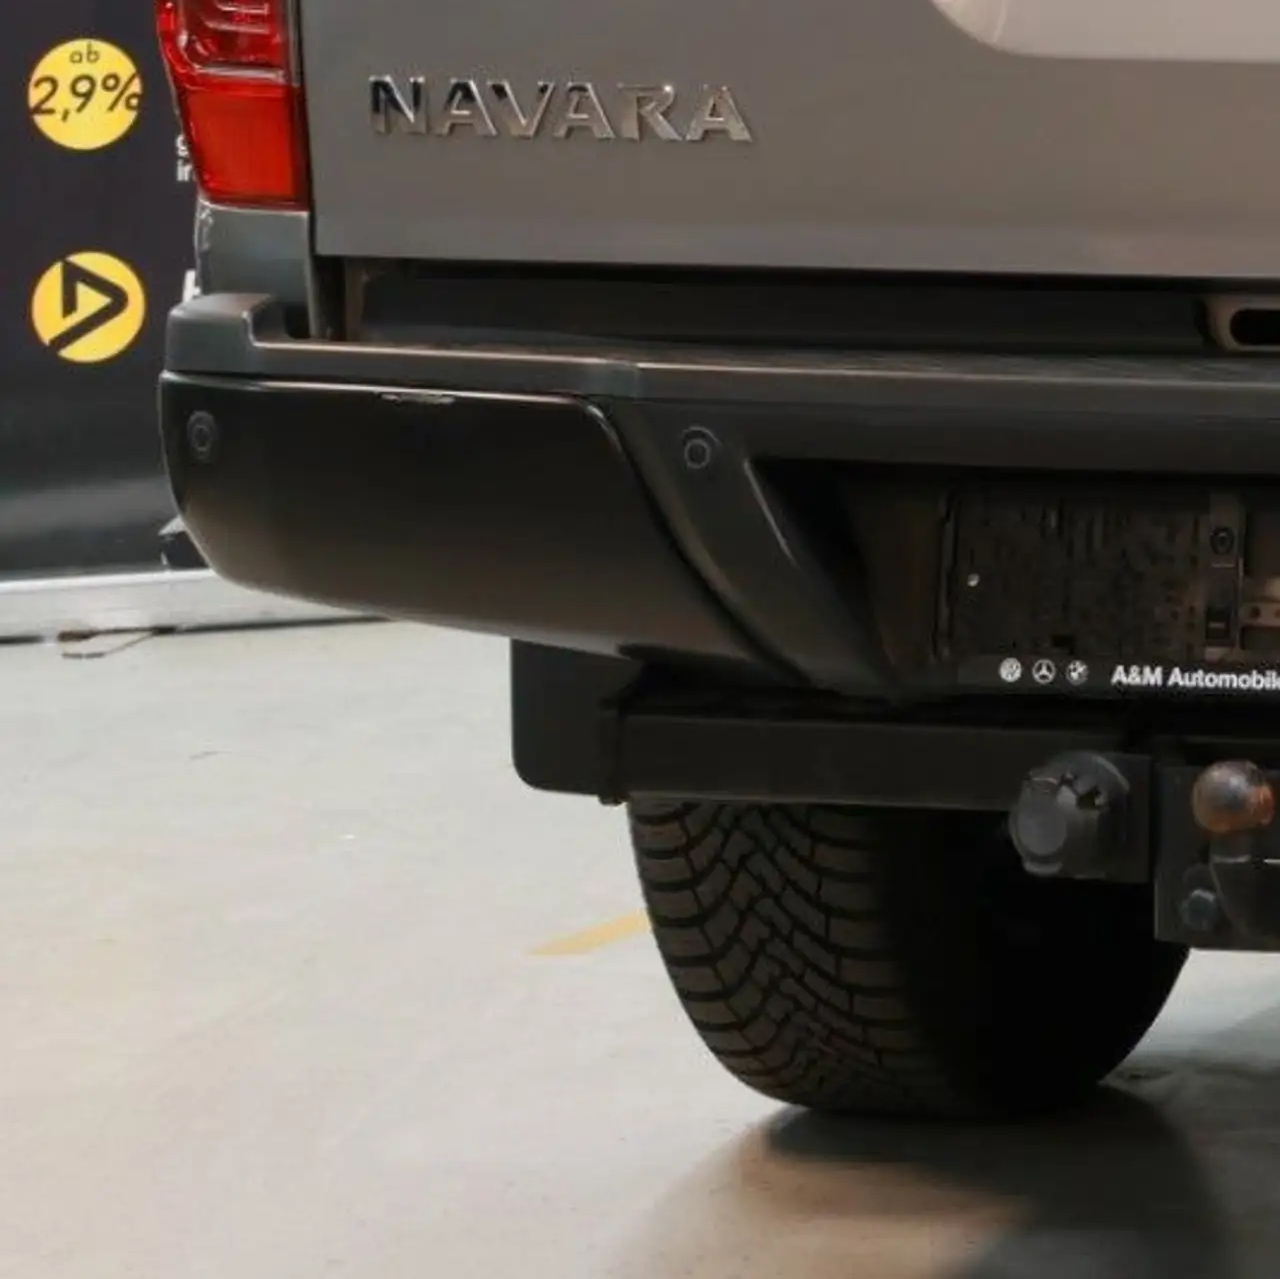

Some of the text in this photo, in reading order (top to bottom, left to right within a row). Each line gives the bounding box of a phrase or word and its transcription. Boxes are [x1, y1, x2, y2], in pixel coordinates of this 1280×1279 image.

[69, 42, 100, 63] ab
[31, 72, 142, 122] 2,9%
[369, 74, 752, 143] NAVARA
[1111, 665, 1162, 687] A&M
